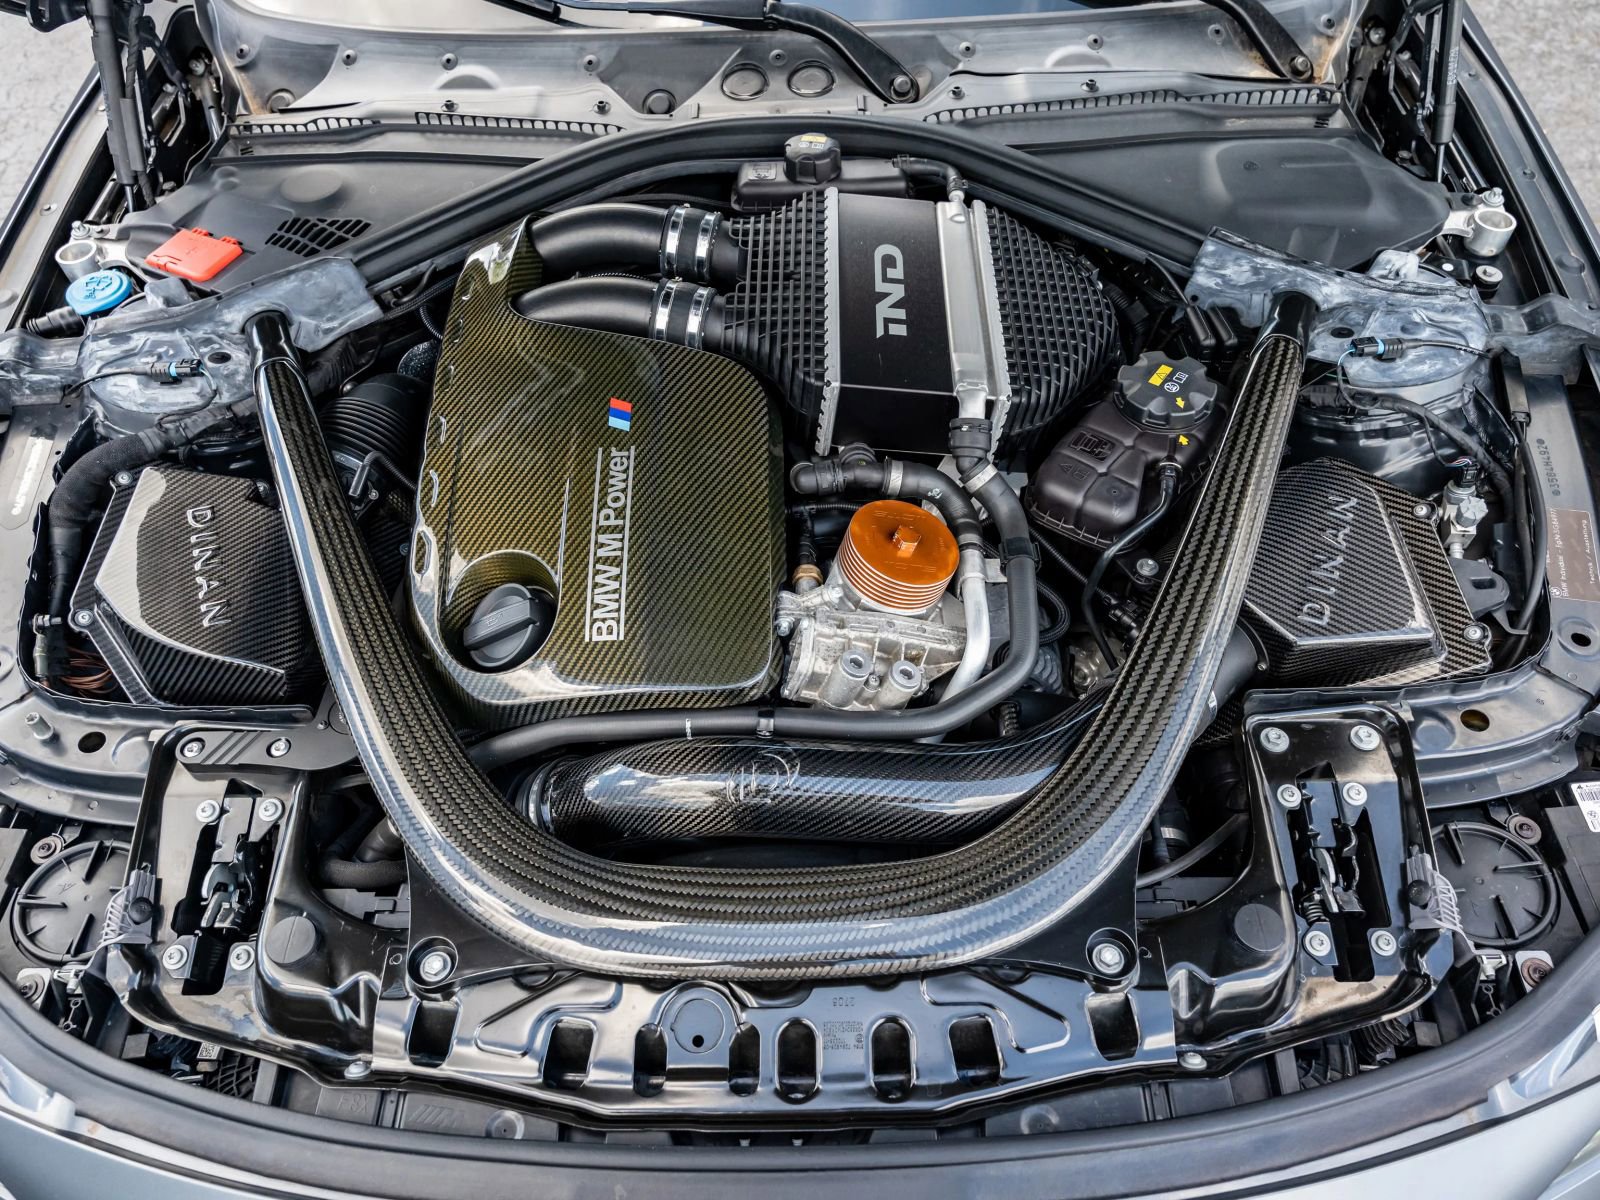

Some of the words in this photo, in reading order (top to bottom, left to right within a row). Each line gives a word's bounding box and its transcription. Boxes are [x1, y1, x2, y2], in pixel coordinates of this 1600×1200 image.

[599, 447, 630, 526] Power
[186, 504, 231, 627] DINAN
[597, 533, 623, 556] M
[1297, 496, 1357, 626] DINAN
[592, 564, 620, 642] BMW
